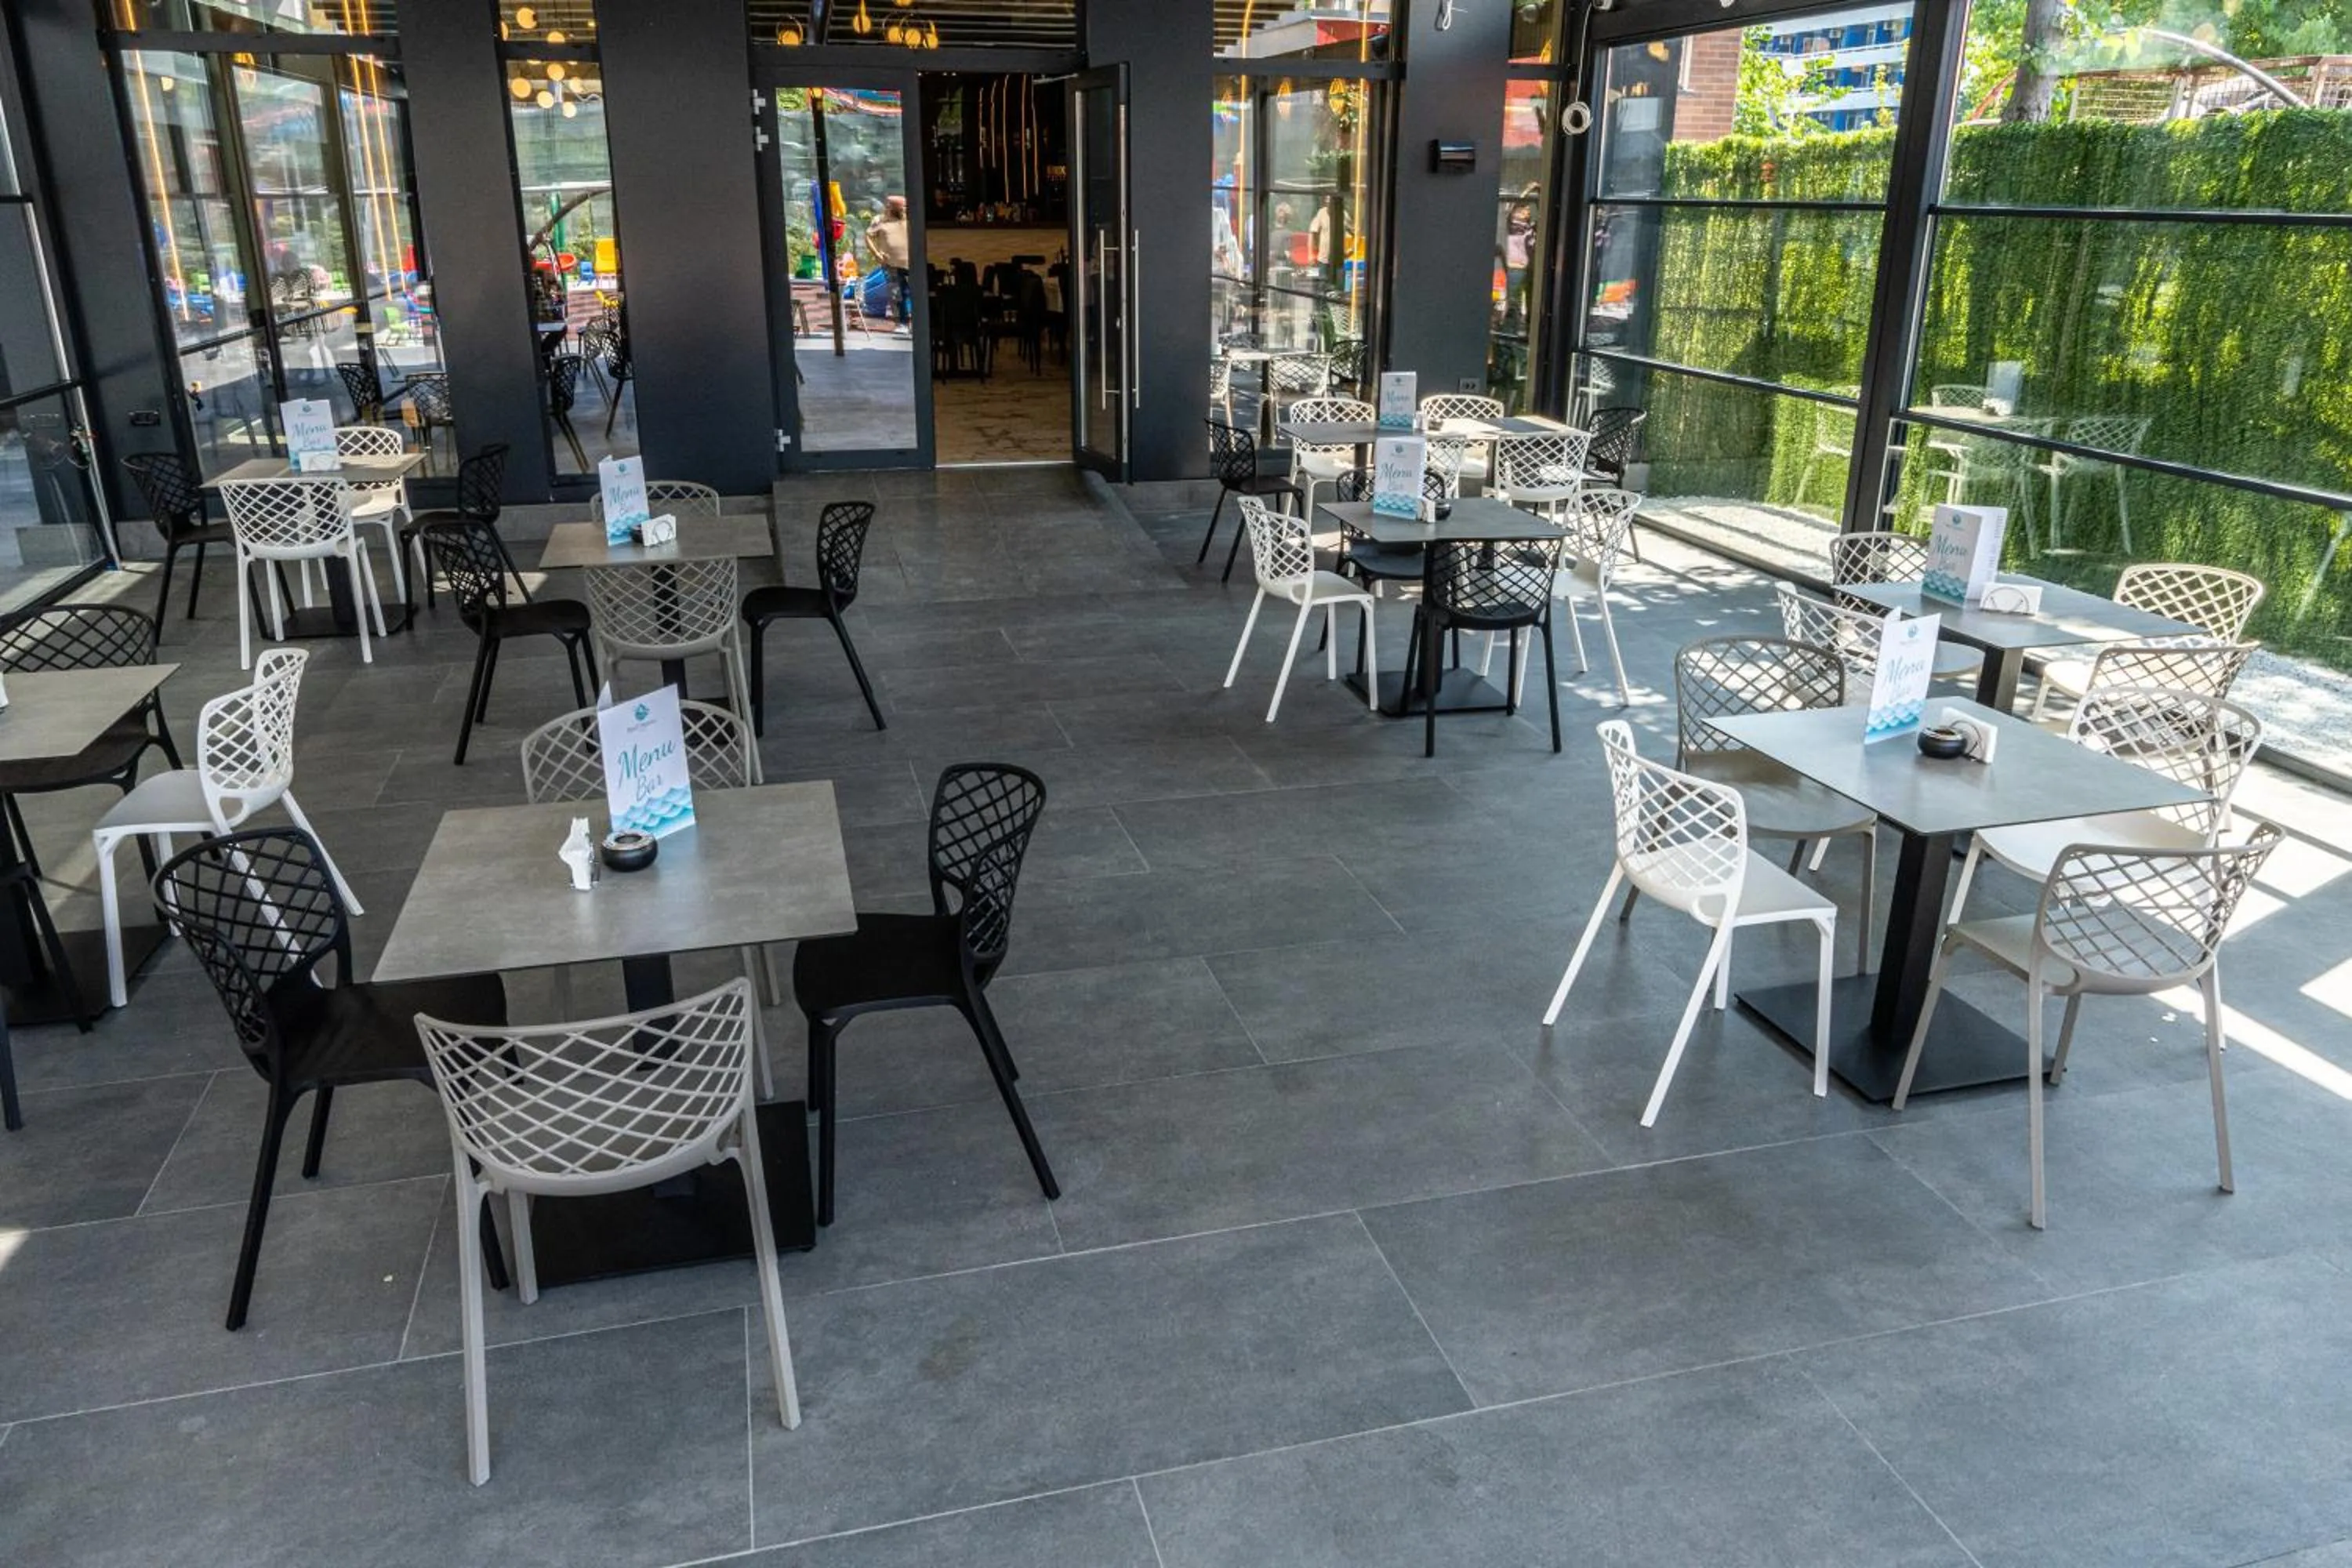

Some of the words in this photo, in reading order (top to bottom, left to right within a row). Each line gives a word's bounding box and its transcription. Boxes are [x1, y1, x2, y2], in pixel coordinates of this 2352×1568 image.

[1379, 462, 1412, 480] Menu
[608, 484, 640, 506] Menu
[1932, 534, 1968, 557] Menu
[1882, 655, 1926, 688] Menu
[617, 739, 676, 789] Menu
[636, 773, 661, 801] Bar
